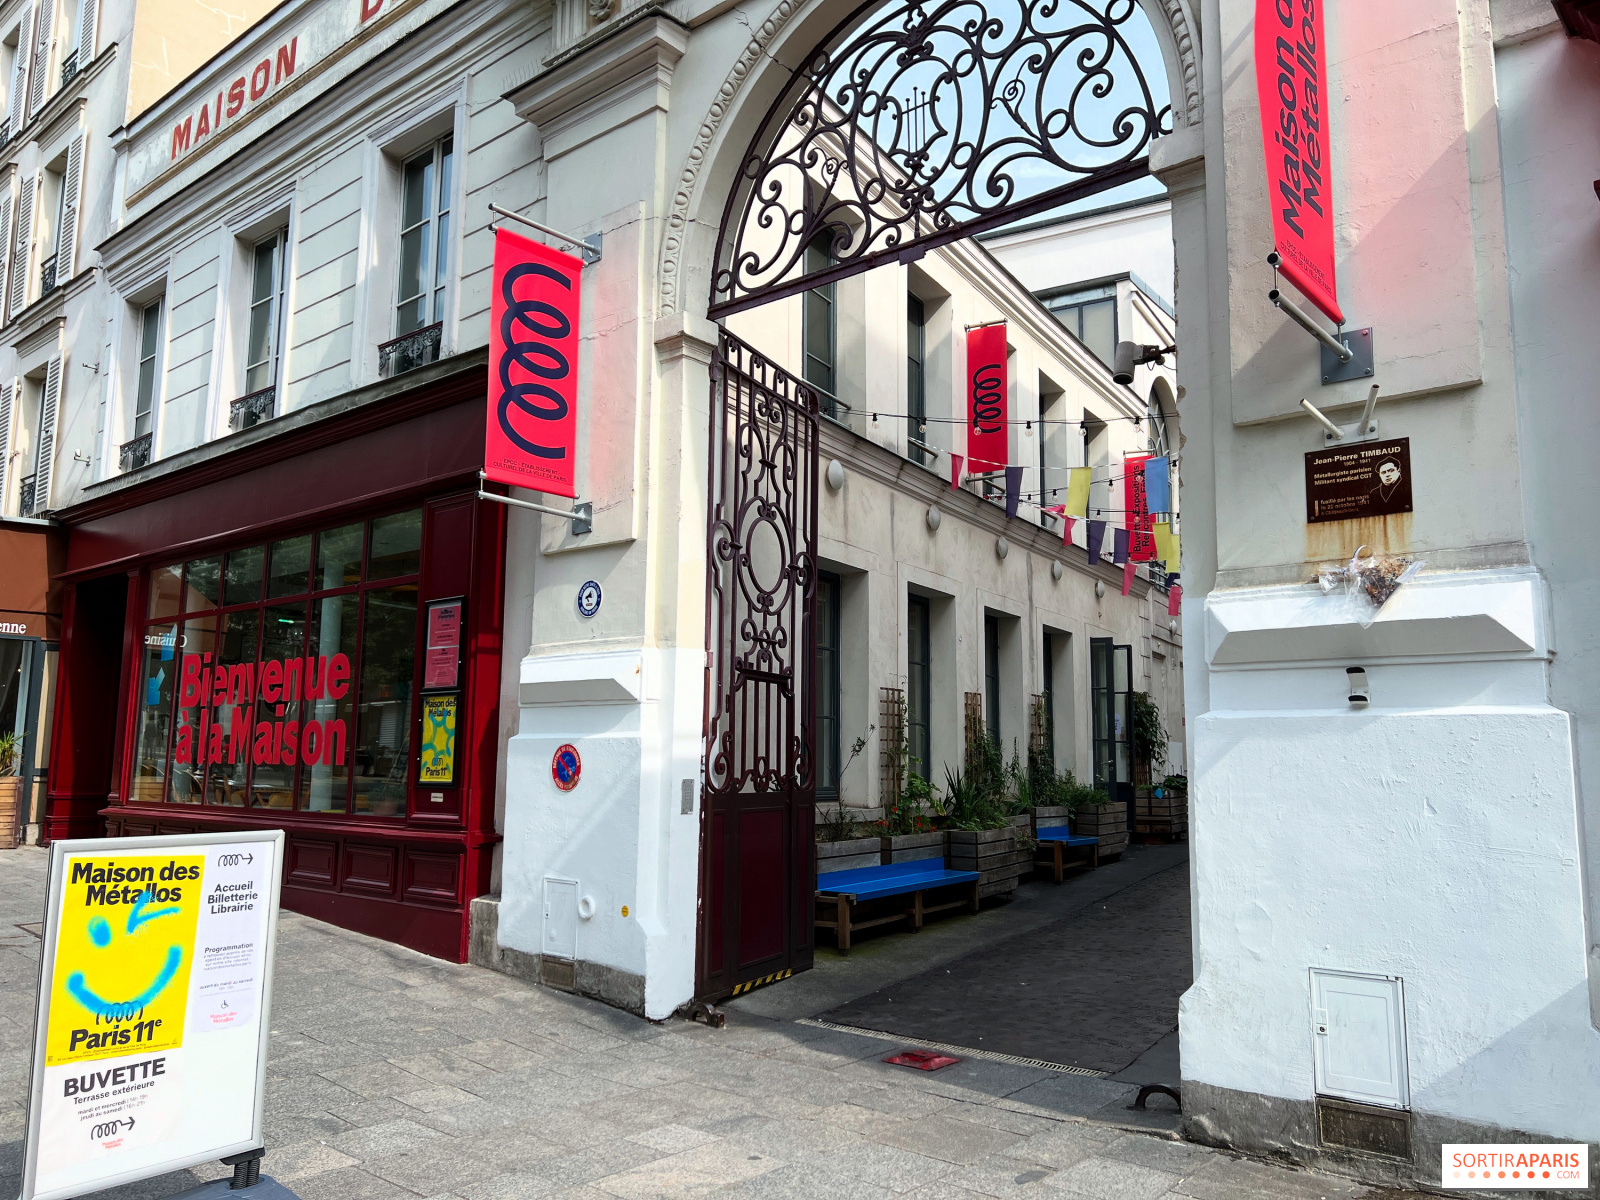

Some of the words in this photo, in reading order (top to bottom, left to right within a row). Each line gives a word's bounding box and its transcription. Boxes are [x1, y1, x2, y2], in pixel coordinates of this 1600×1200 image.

[170, 36, 298, 161] MAISON
[1297, 0, 1323, 218] Métallos
[1275, 36, 1304, 240] Maison
[494, 462, 517, 471] CULTUREL
[1314, 454, 1358, 465] Jean-Pierre
[1360, 446, 1401, 458] TIMBAUD
[179, 652, 350, 708] Bienvenue
[176, 710, 192, 765] à
[197, 709, 222, 765] la
[228, 704, 346, 766] Maison
[426, 767, 440, 776] Paris
[72, 862, 154, 884] Maison
[160, 861, 200, 881] des
[86, 883, 182, 906] Métallos
[208, 891, 258, 904] Billetterie
[214, 881, 253, 893] Accueil
[211, 902, 253, 914] Librairie
[205, 943, 253, 953] Programmation
[69, 1024, 131, 1052] Paris
[64, 1057, 166, 1097] BUVETTE
[74, 1091, 110, 1104] Terrasse
[112, 1080, 154, 1096] extérieure
[78, 1106, 93, 1115] mardi
[102, 1098, 126, 1109] mercredi
[80, 1113, 94, 1121] jeudi
[103, 1106, 122, 1115] samedi
